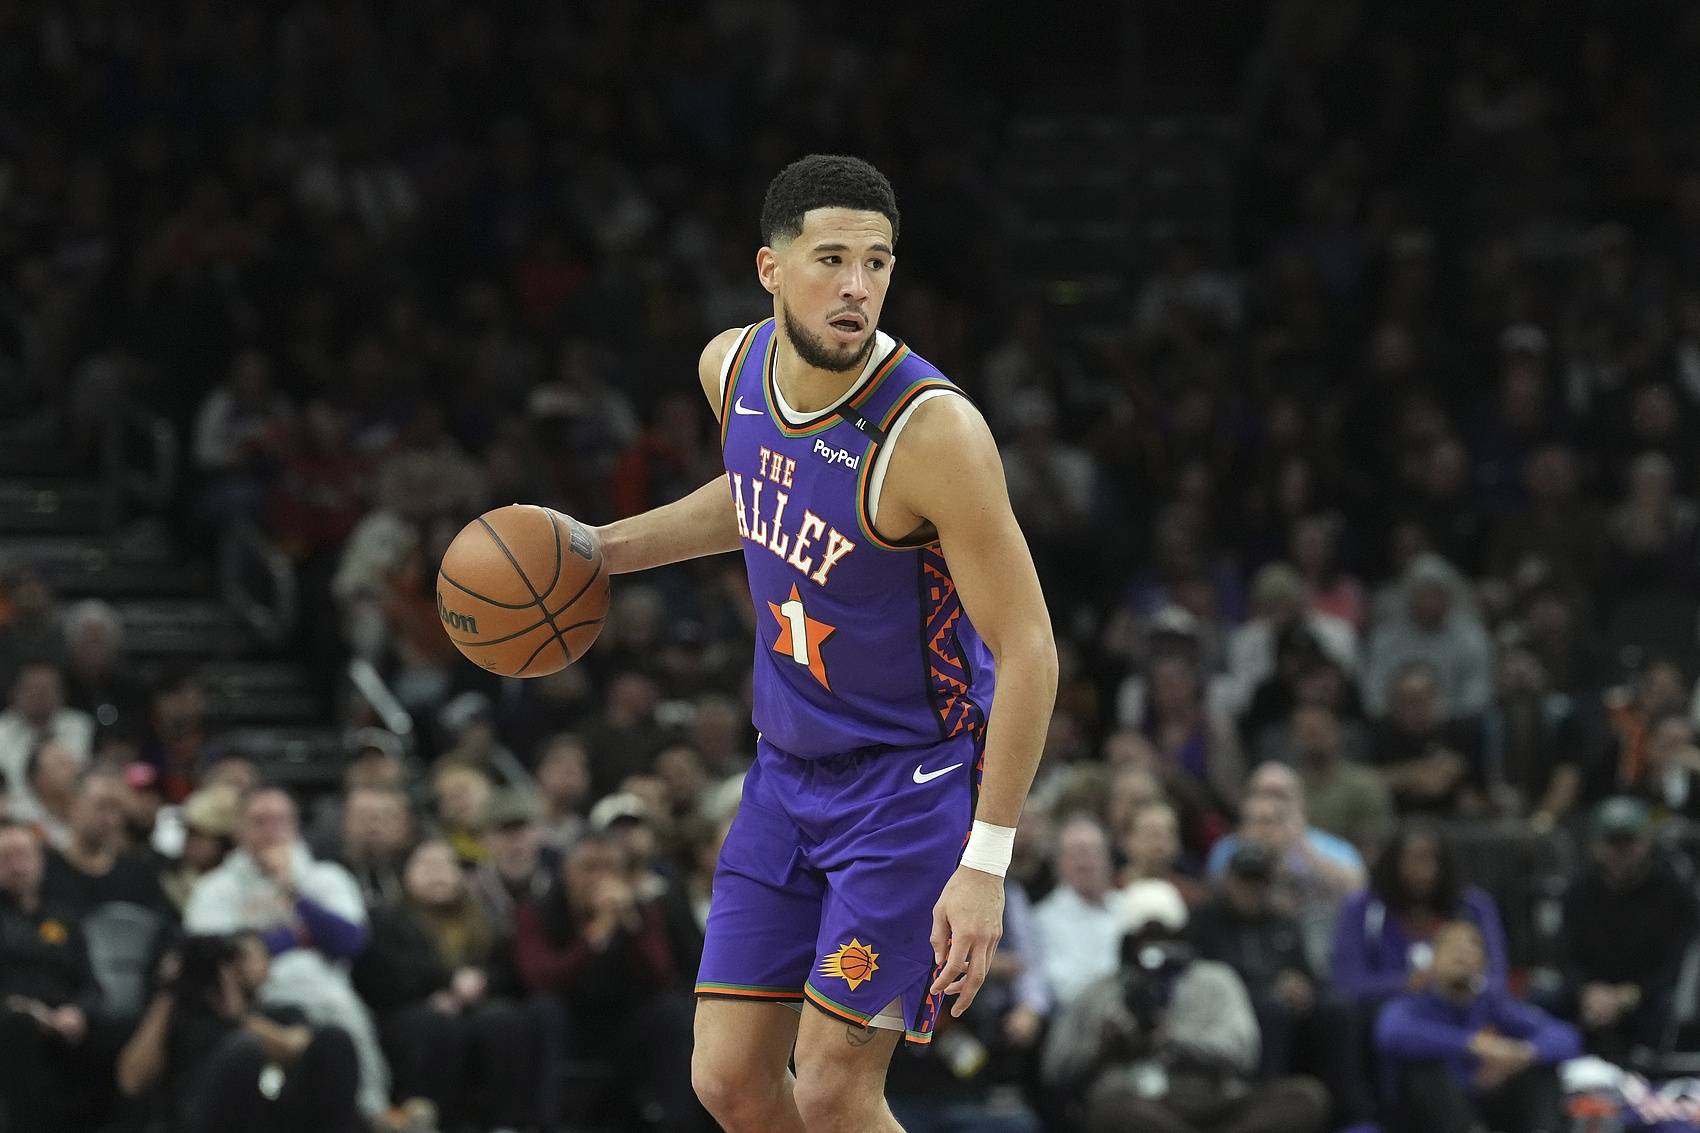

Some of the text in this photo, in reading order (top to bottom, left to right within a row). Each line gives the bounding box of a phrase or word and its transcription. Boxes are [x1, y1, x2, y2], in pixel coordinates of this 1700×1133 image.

[855, 417, 867, 431] AL
[760, 446, 797, 489] THE
[813, 438, 860, 470] PayPal
[780, 599, 810, 666] 1
